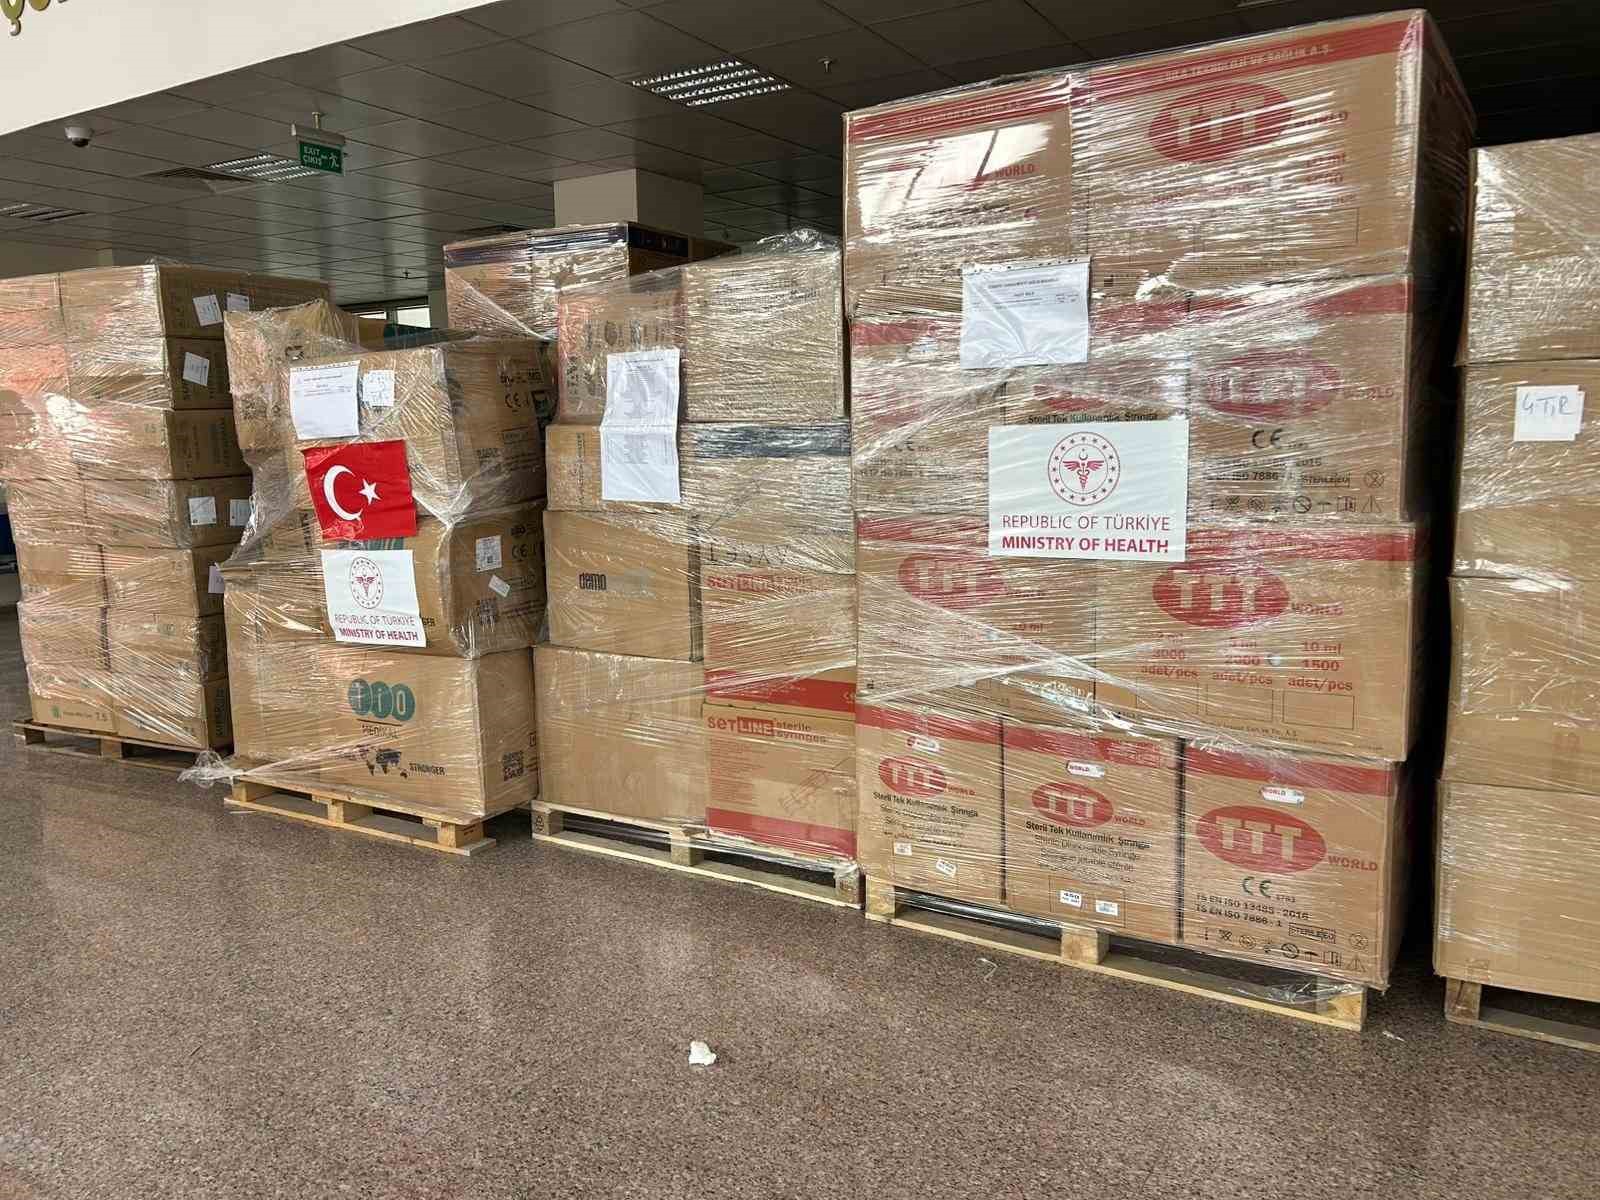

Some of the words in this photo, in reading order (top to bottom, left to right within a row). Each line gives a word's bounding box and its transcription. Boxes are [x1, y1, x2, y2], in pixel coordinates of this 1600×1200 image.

[994, 163, 1036, 179] WORLD
[1002, 514, 1072, 529] REPUBLIC
[1078, 515, 1098, 530] OF
[1104, 513, 1171, 531] TÜRKİYE
[1002, 536, 1074, 551] MINISTRY
[1079, 537, 1099, 552] OF
[1104, 538, 1169, 553] HEALTH
[334, 614, 369, 625] REPUBLIC
[370, 615, 380, 625] OF
[339, 628, 373, 639] MINISTRY
[375, 630, 387, 639] OF
[387, 631, 418, 641] HEALTH
[1287, 675, 1354, 692] adet/pcs
[776, 720, 812, 732] sterile
[1025, 820, 1048, 833] Steril
[1049, 824, 1064, 836] Tek
[1215, 815, 1302, 863] TTT
[1328, 855, 1378, 872] WORLD
